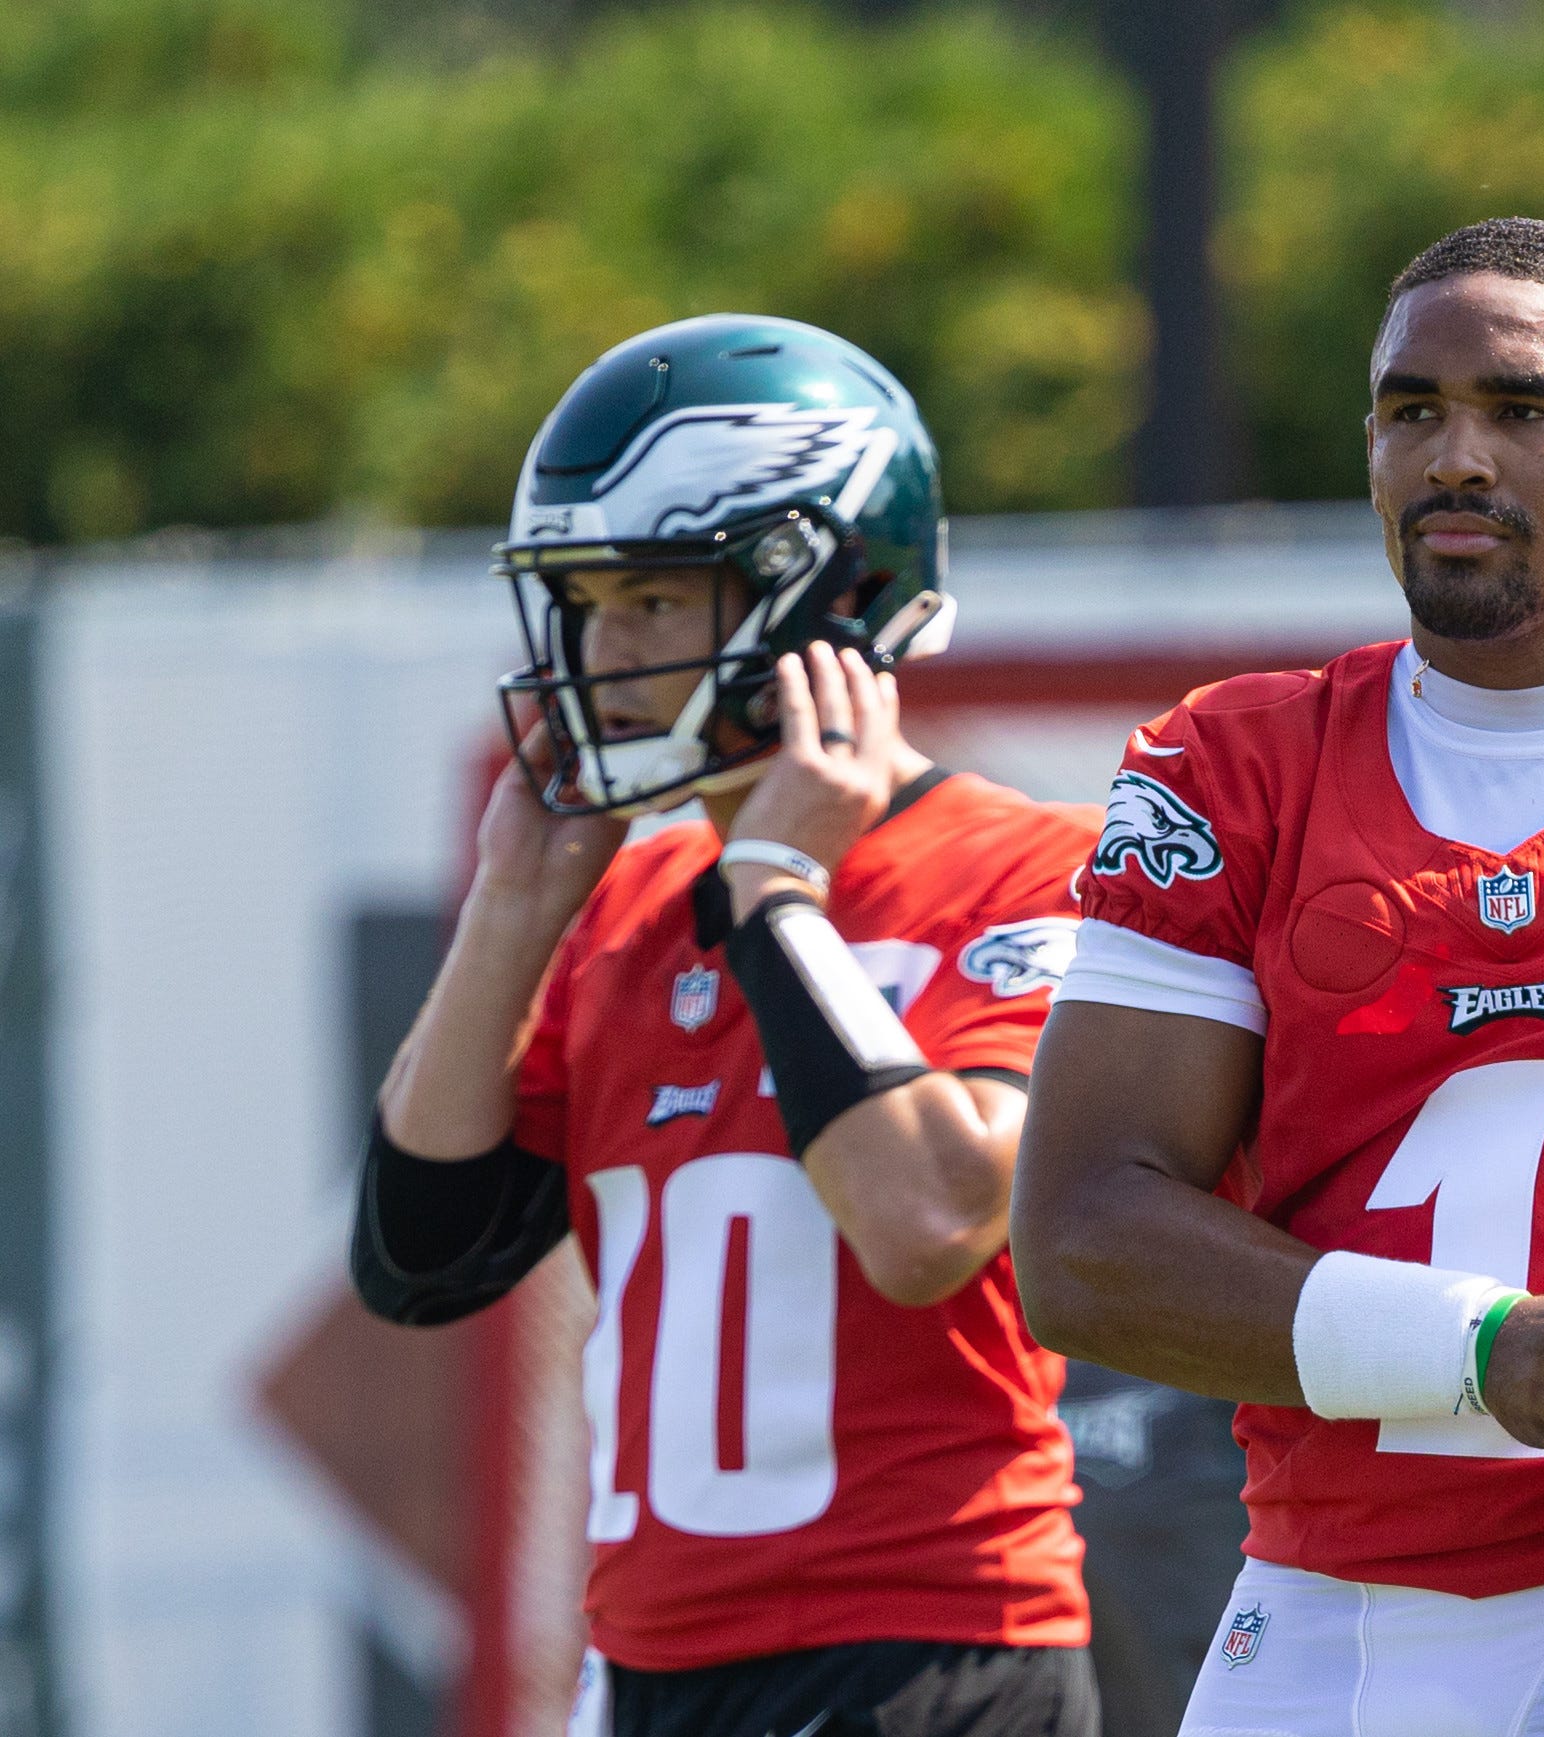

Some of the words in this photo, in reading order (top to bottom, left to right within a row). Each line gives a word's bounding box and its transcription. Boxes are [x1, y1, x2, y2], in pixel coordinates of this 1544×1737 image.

[1488, 896, 1526, 922] NFL
[583, 1152, 838, 1543] 10
[1225, 1631, 1252, 1656] NFL
